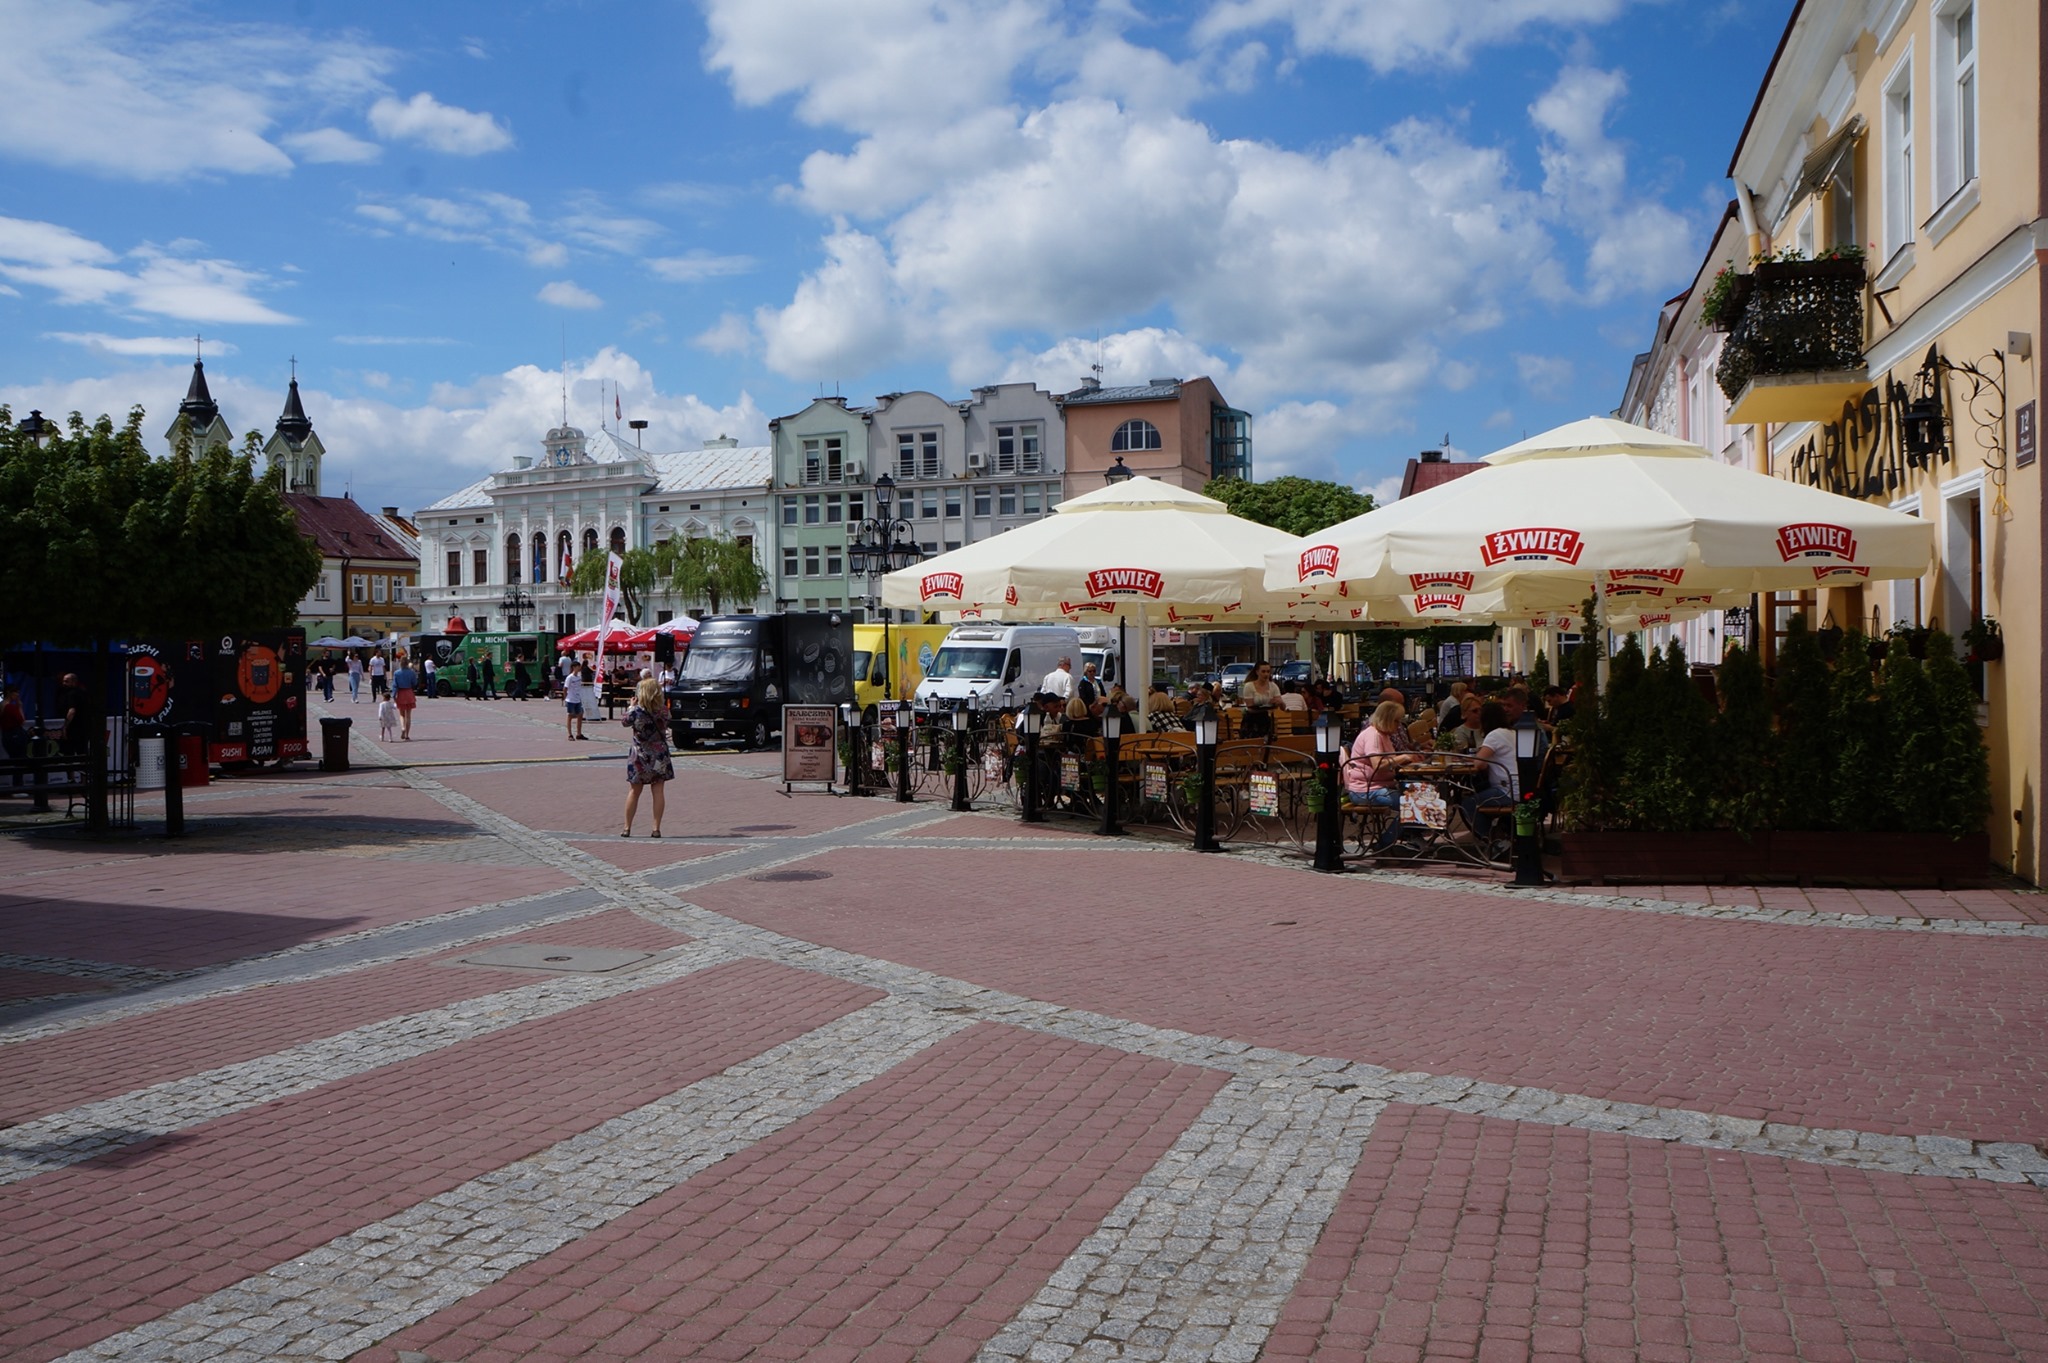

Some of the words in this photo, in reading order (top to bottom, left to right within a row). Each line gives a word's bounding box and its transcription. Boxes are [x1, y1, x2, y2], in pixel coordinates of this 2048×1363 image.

[2020, 410, 2030, 435] 12
[1493, 530, 1573, 555] ŻYWIEC
[1785, 526, 1847, 550] ŻYWIEC
[1303, 547, 1337, 572] ŻYWIEC
[925, 574, 960, 593] ŻYWIEC
[1094, 571, 1156, 590] ŻYWIEC
[221, 747, 243, 758] SUSHI
[251, 745, 273, 756] ASIAN
[283, 742, 302, 753] FOOD
[1257, 783, 1276, 793] GIER
